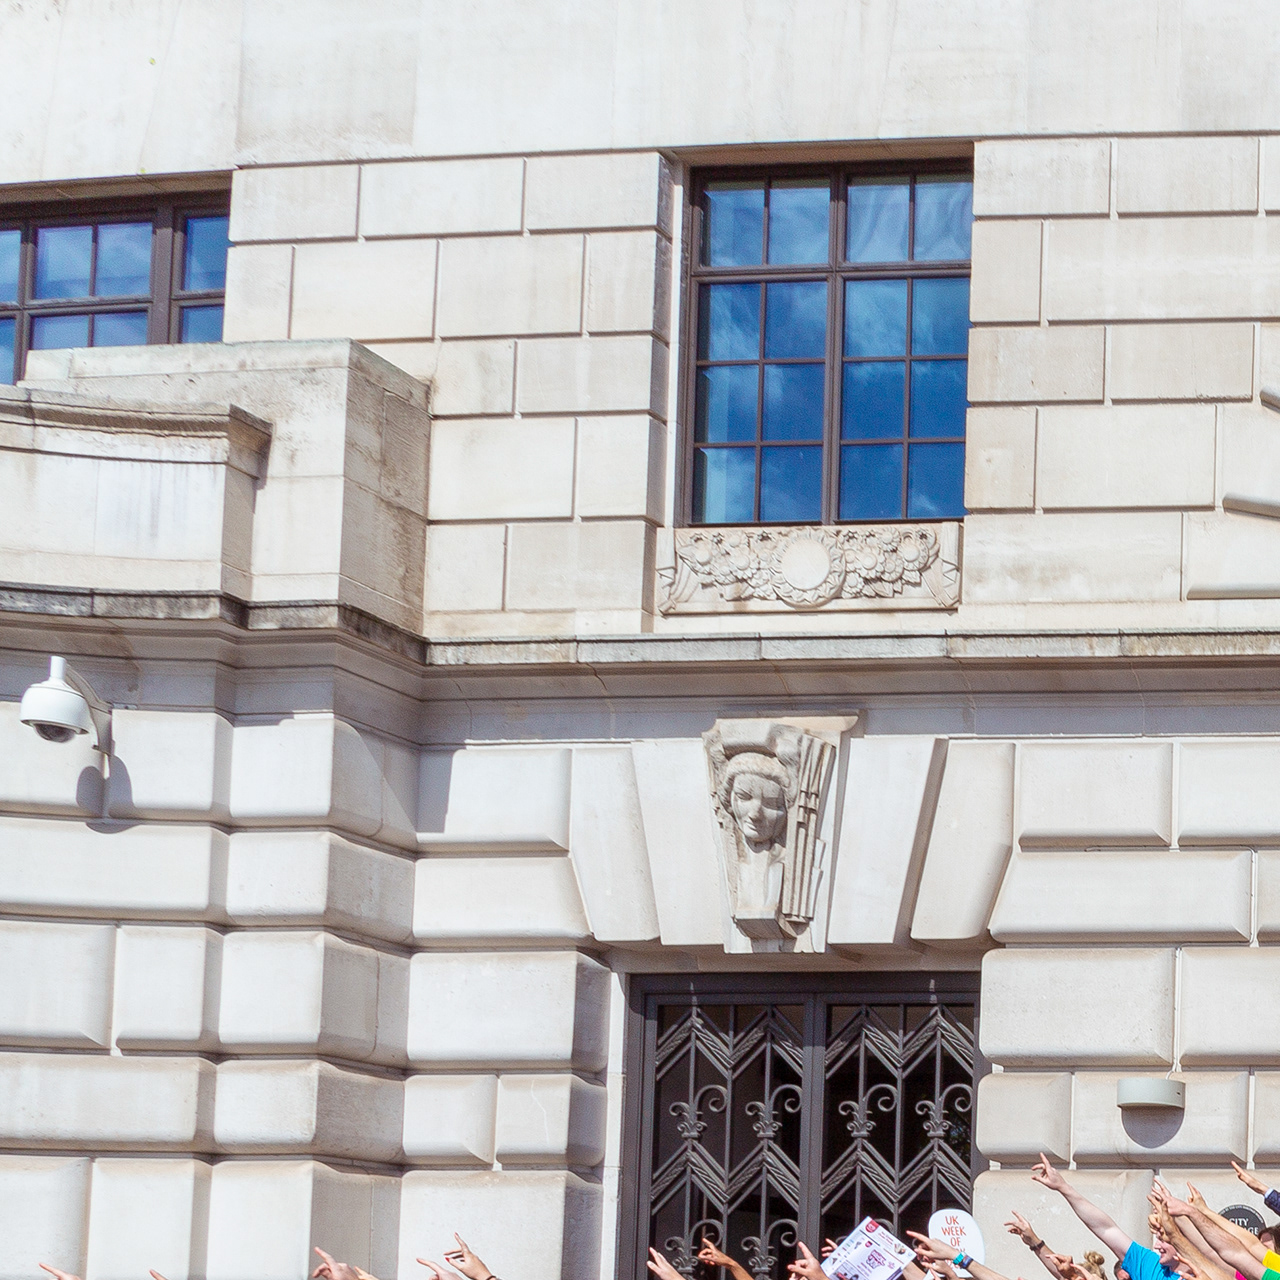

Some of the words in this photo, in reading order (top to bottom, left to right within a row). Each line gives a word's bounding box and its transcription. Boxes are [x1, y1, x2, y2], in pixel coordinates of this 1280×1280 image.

[945, 1215, 959, 1225] UK
[941, 1226, 967, 1236] WEEK
[950, 1237, 960, 1247] OF
